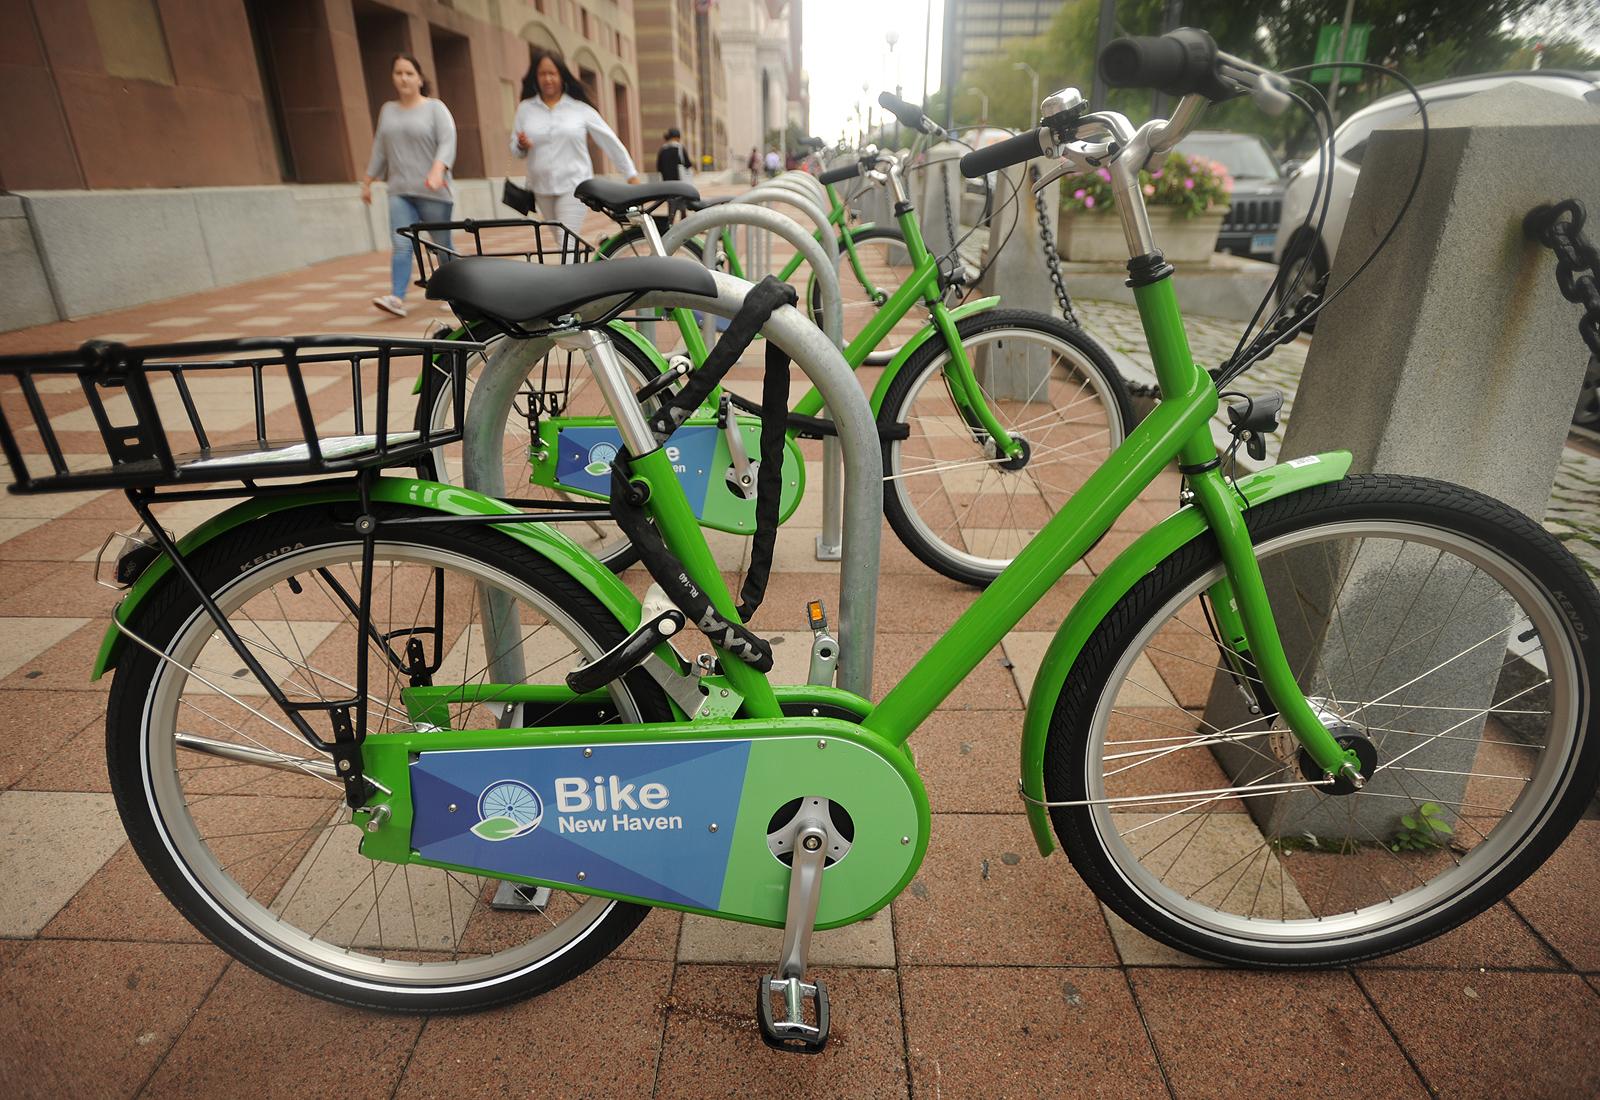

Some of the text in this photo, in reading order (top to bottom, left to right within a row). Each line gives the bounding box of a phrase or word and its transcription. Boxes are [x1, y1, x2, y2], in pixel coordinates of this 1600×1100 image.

[240, 542, 305, 572] KENDA
[697, 605, 762, 662] AXA
[1553, 590, 1589, 641] KENDA
[554, 774, 670, 813] Bike
[558, 814, 683, 834] New Haven
